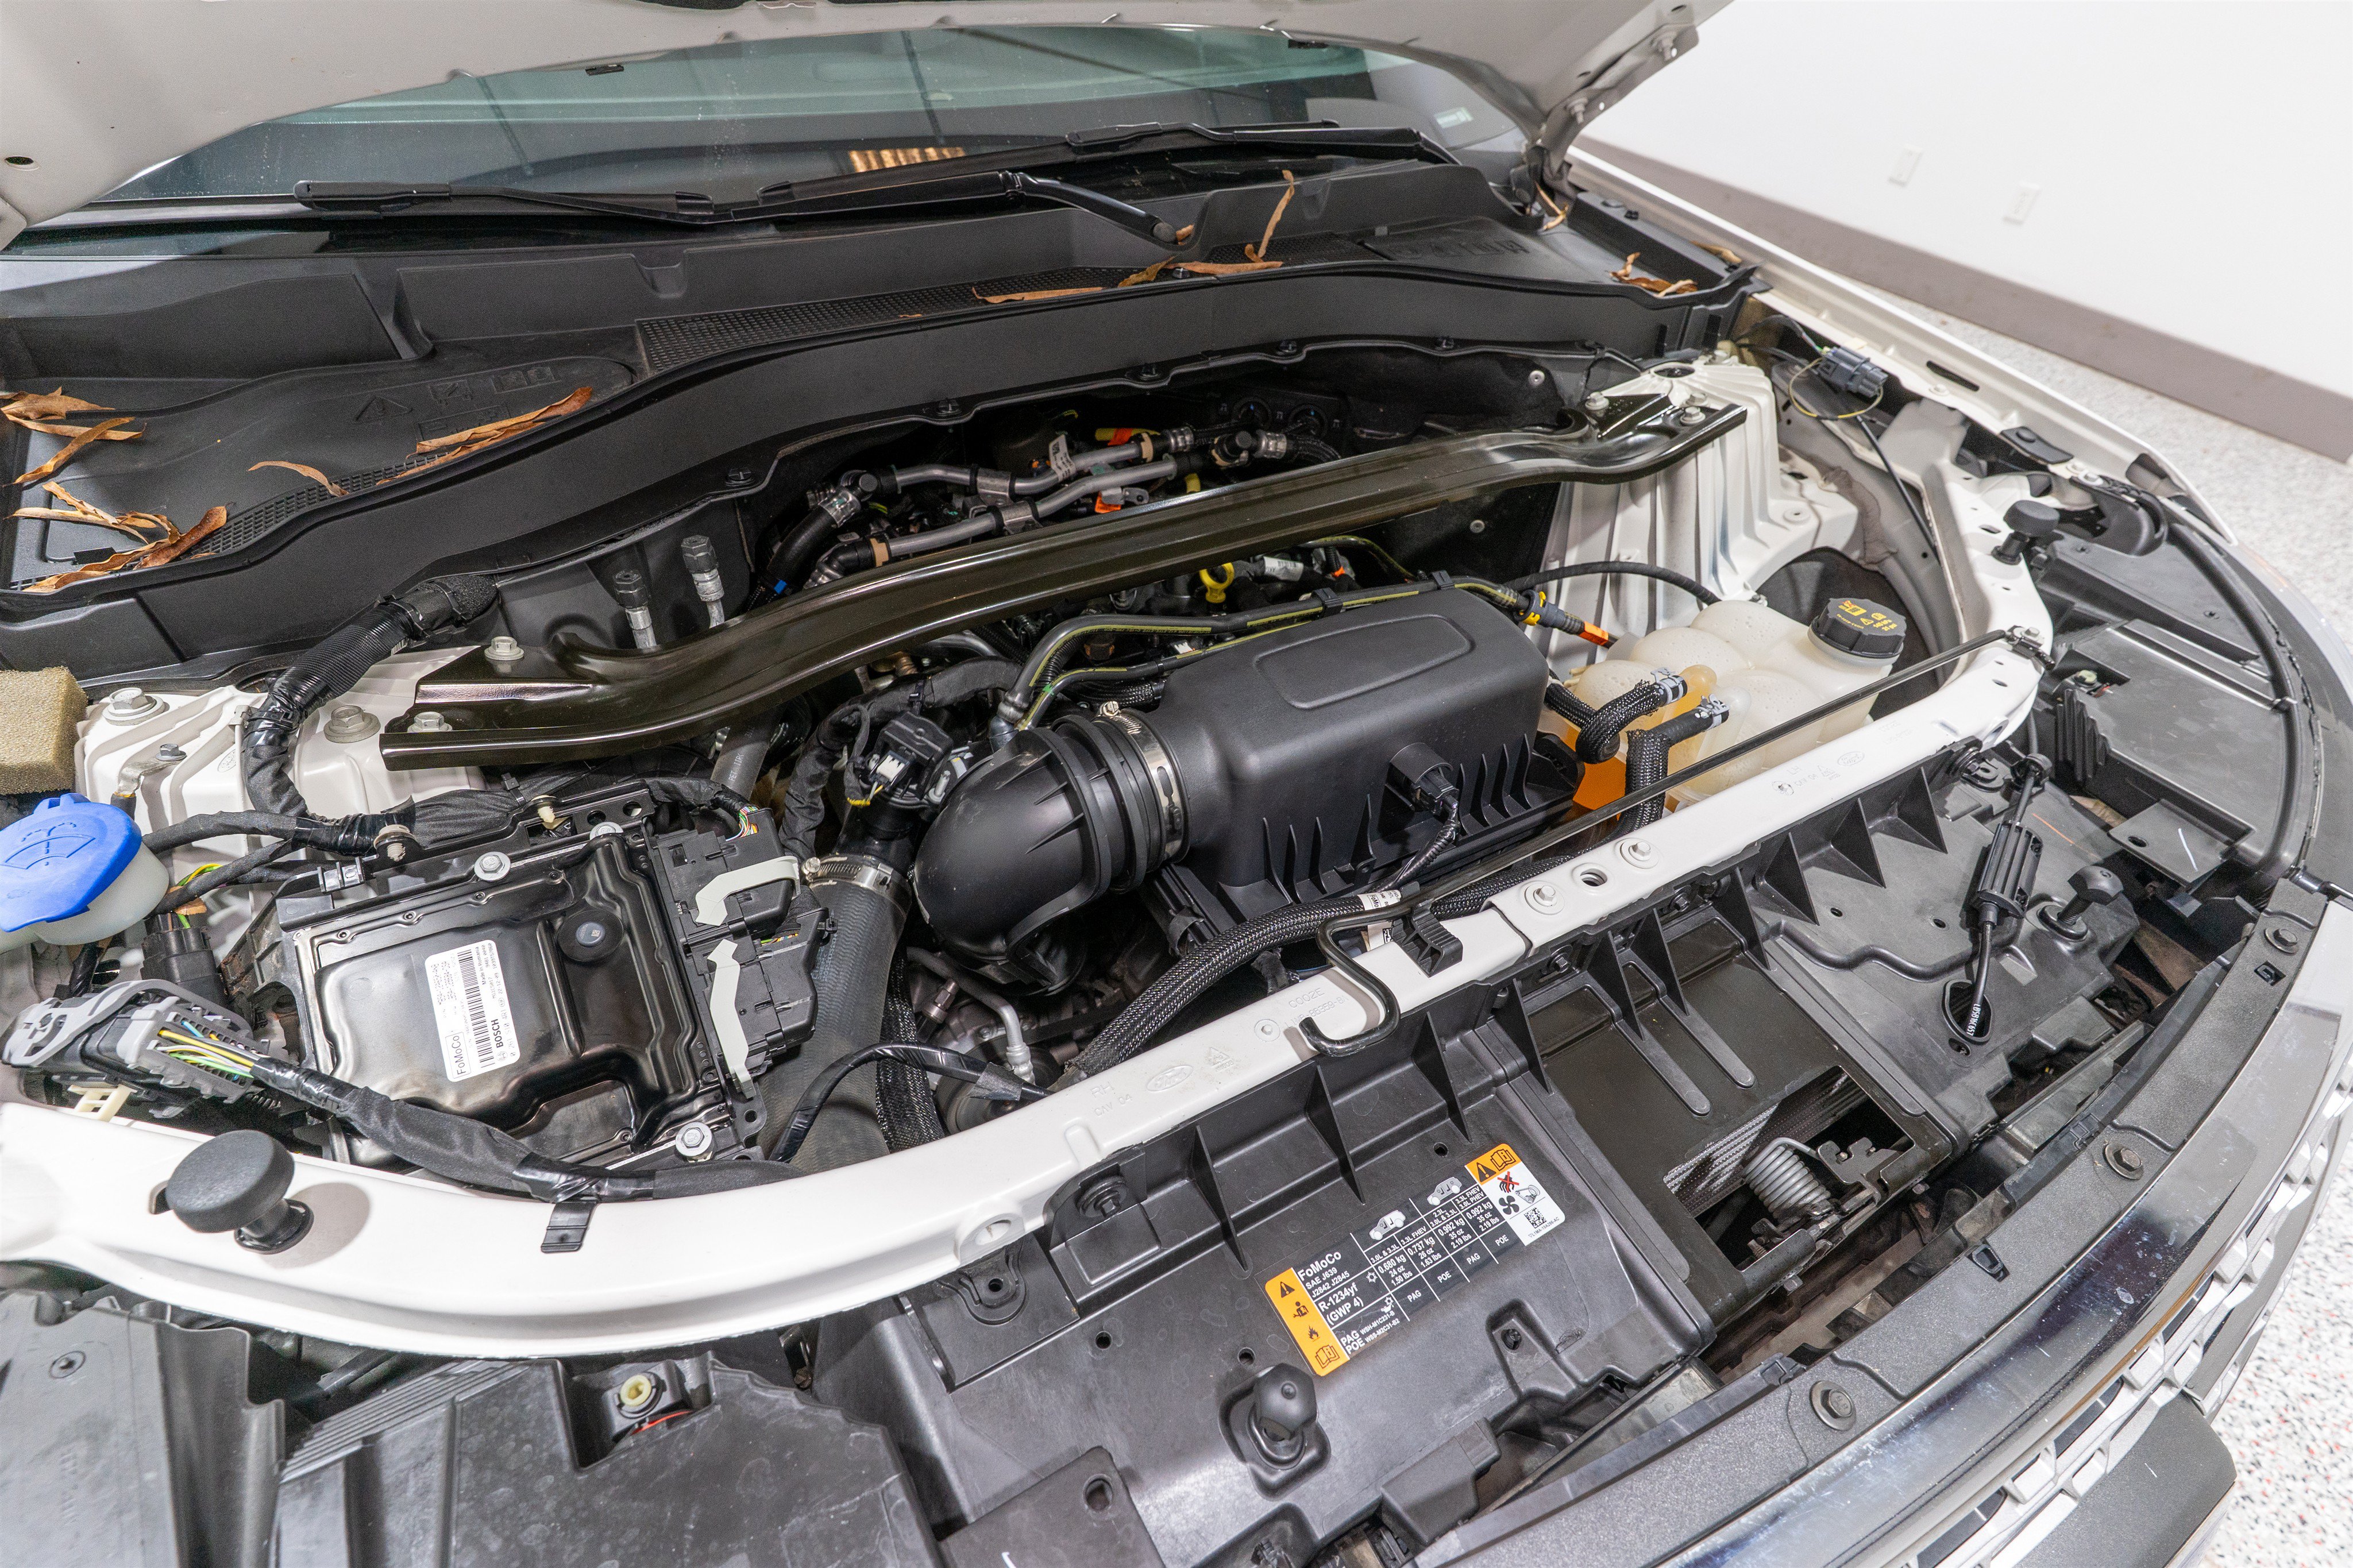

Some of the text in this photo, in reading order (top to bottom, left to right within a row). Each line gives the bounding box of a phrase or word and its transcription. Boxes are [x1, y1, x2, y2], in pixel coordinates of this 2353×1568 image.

[491, 1019, 503, 1048] BOSCH
[452, 1036, 466, 1075] FoMoCo
[1090, 1082, 1114, 1098] RH
[1094, 1094, 1133, 1117] CAV 04
[1455, 1186, 1480, 1204] 3.3L FHEV
[1459, 1192, 1485, 1210] 3.0L PHEV
[1430, 1216, 1442, 1227] 3.0L
[1446, 1208, 1458, 1218] 3.3L
[1433, 1208, 1447, 1218] 2.3L,
[1466, 1201, 1493, 1220] 0.992 kg
[1477, 1212, 1492, 1223] 35 oz
[1438, 1218, 1465, 1237] 0.992 kg
[1479, 1216, 1500, 1232] 2.19 lbs
[1401, 1226, 1427, 1245] 3.3L FHEV
[1448, 1232, 1457, 1240] 35
[1451, 1233, 1472, 1250] 2.19 lbs
[1495, 1234, 1509, 1246] POE
[1371, 1253, 1382, 1264] 3.0L
[1387, 1244, 1399, 1254] 3.3L
[1407, 1235, 1436, 1256] 0.737 kg
[1418, 1246, 1434, 1260] 26 oz
[1298, 1251, 1342, 1281] FoMoCo
[1378, 1254, 1407, 1274] 0.680 kg
[1420, 1252, 1442, 1268] 1.63 lbs
[1466, 1253, 1481, 1265] PAG
[1306, 1268, 1337, 1289] SAE J639
[1388, 1265, 1406, 1278] 24 oz
[1391, 1270, 1413, 1287] 1.50 lbs
[1437, 1271, 1452, 1283] POE
[1311, 1271, 1350, 1298] J2842 J2845
[1318, 1282, 1358, 1312] R-1234yf
[1407, 1290, 1422, 1303] PAG
[1326, 1296, 1364, 1325] (GWP 4)
[1340, 1310, 1395, 1346] PAG WSH-M1C231-B
[1345, 1338, 1365, 1354] POE
